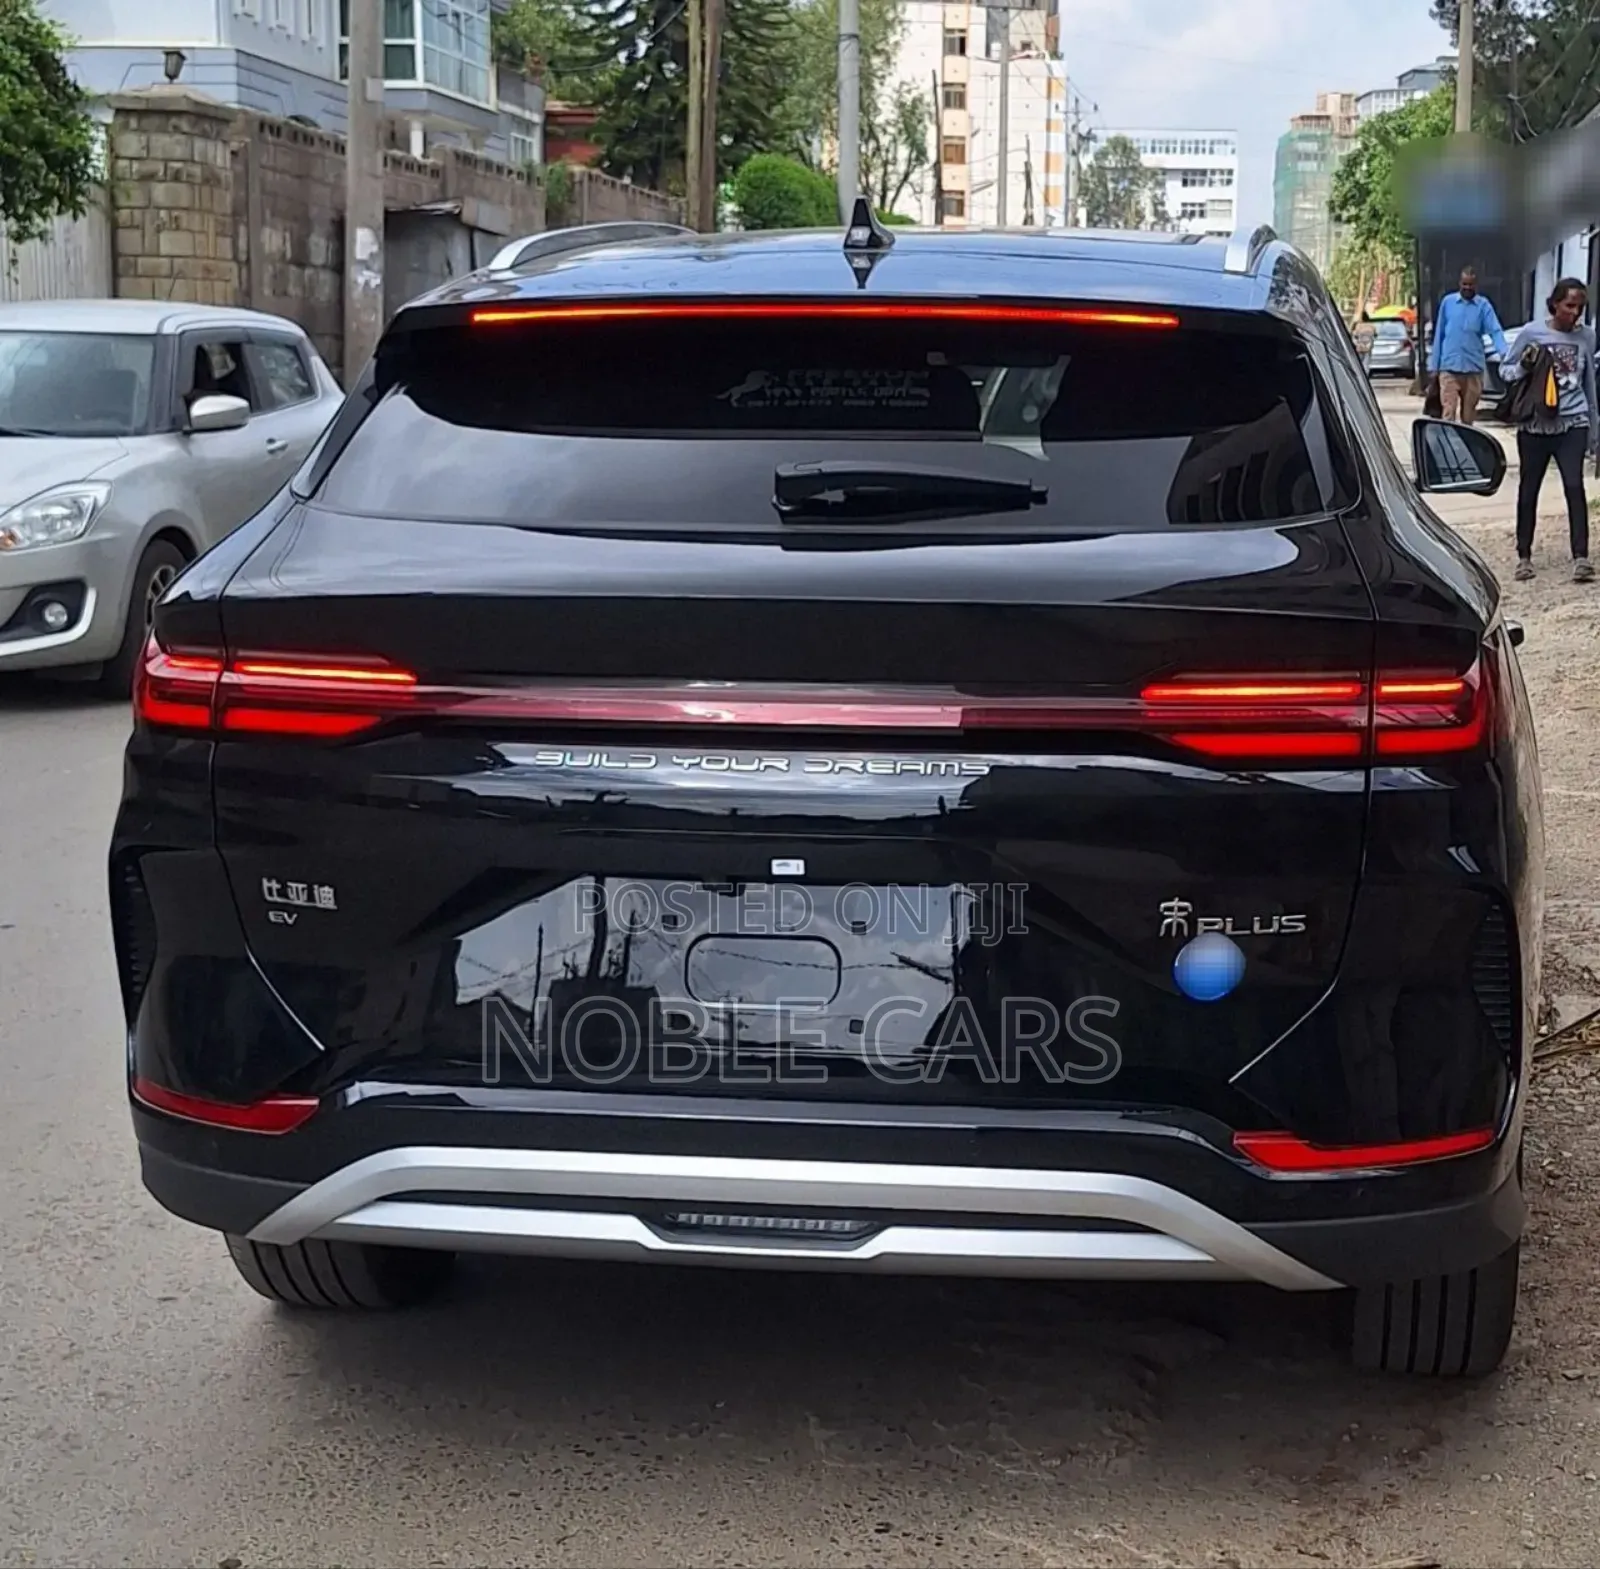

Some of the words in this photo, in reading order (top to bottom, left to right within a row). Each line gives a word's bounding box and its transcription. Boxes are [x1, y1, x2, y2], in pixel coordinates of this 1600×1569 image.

[535, 751, 657, 770] BUILD
[672, 754, 790, 773] YOUR
[804, 757, 991, 776] DREAMS
[262, 877, 338, 910] 比亚迪
[268, 911, 298, 925] EV
[1159, 896, 1193, 938] 宋
[1197, 914, 1307, 936] PLUS
